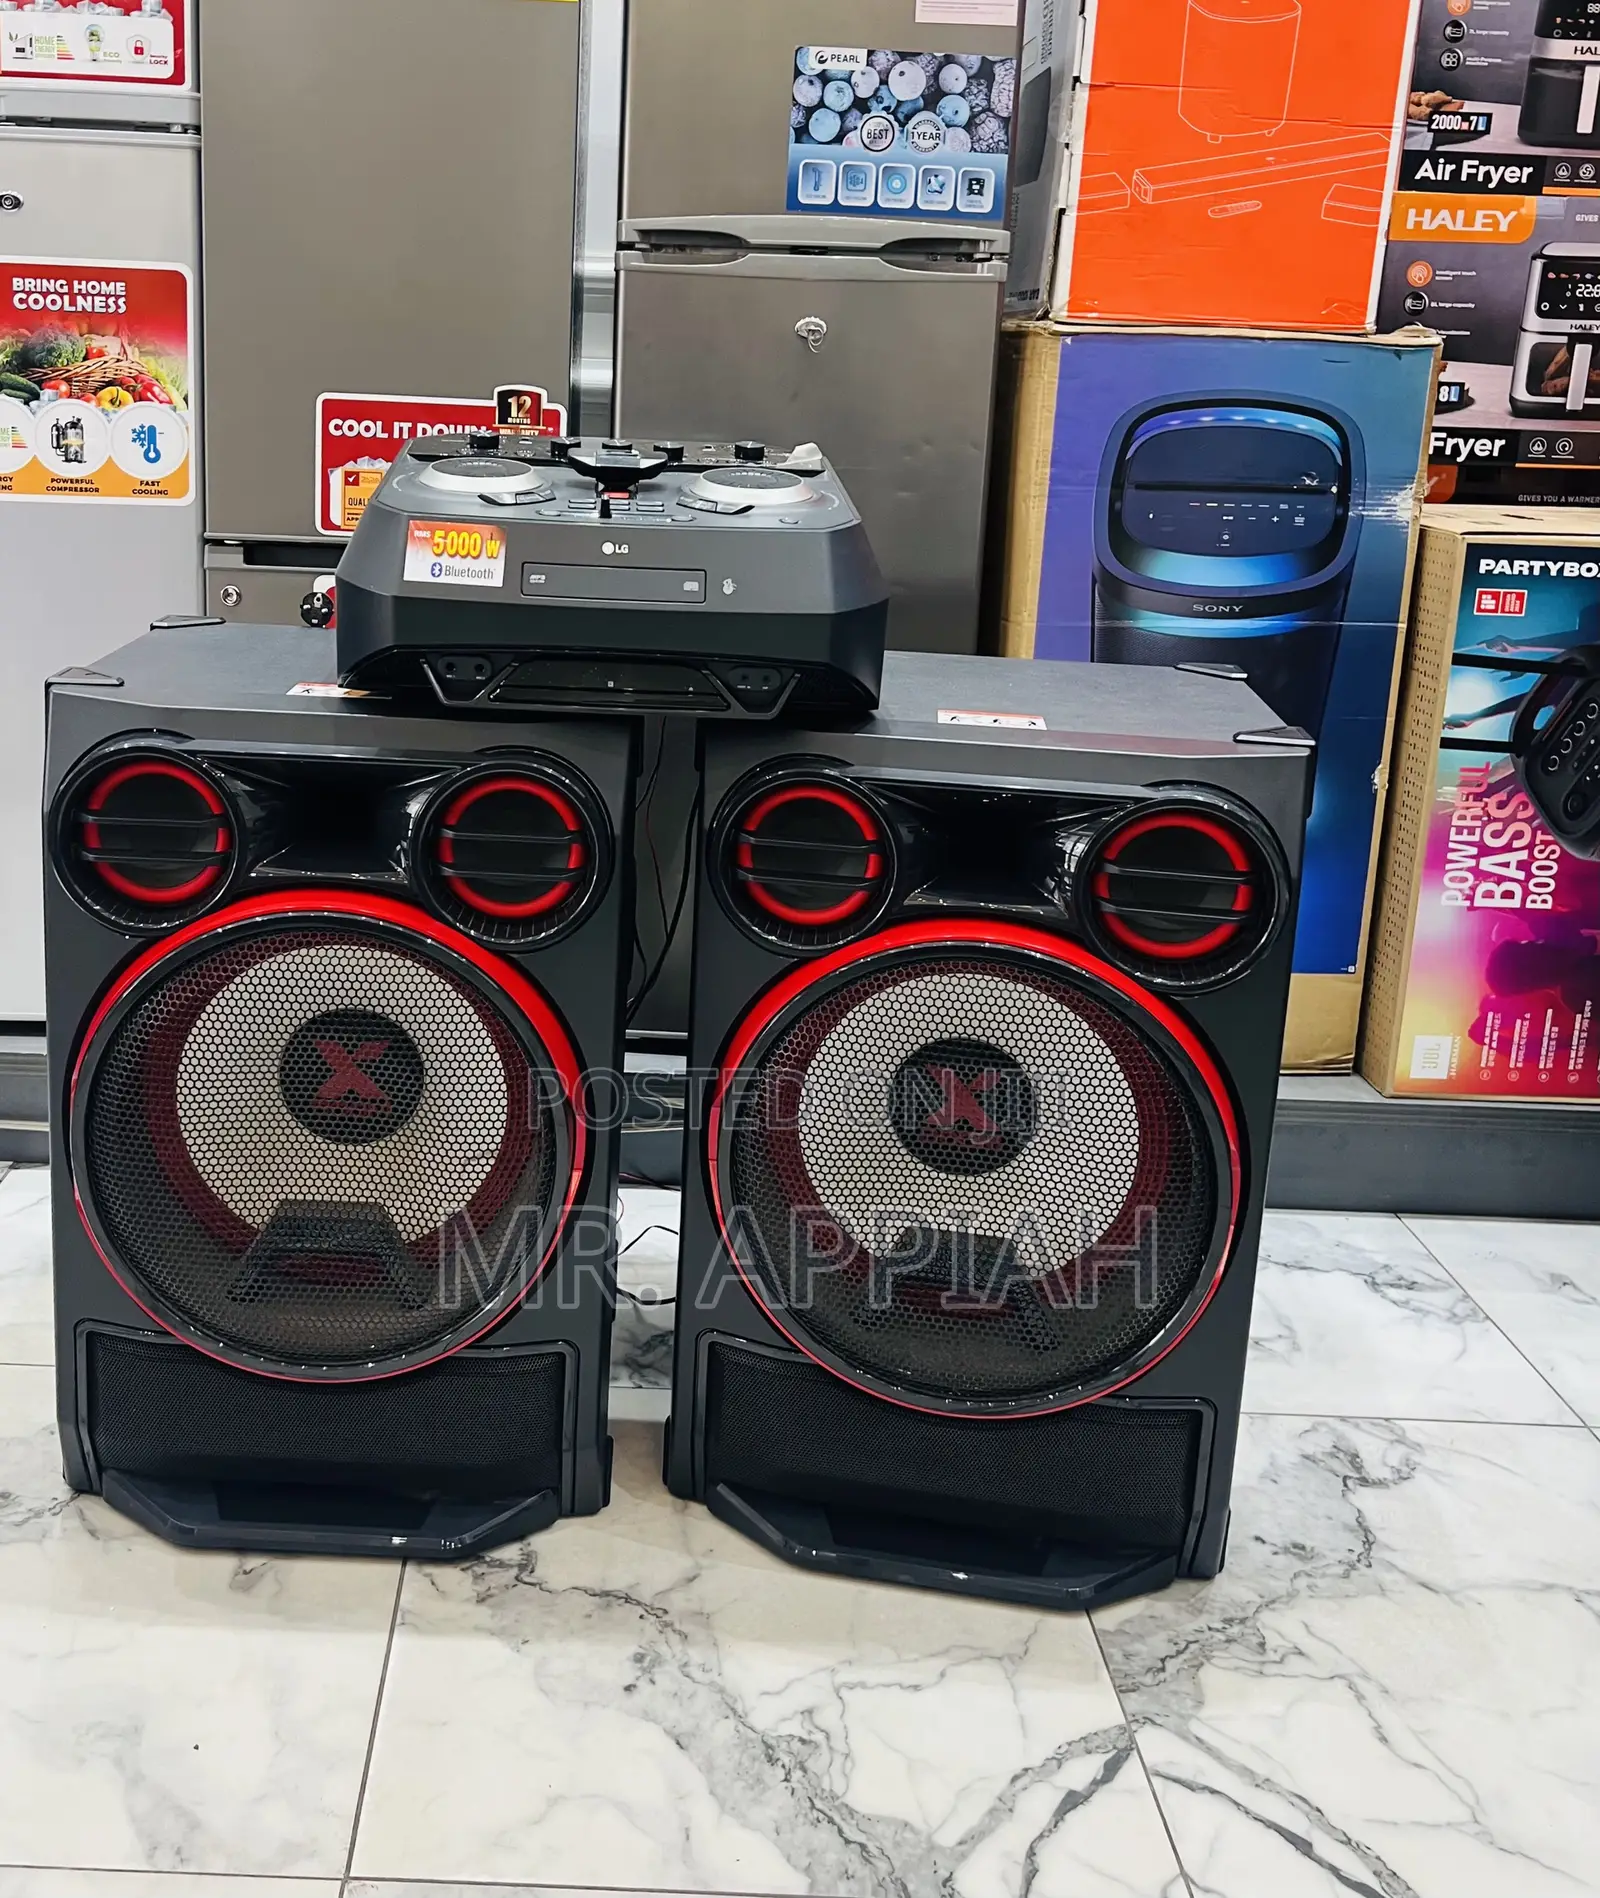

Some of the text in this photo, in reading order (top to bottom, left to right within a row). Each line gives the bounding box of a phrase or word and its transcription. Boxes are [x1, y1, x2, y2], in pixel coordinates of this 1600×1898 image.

[830, 54, 861, 63] PEARL
[867, 129, 889, 140] BEST
[917, 131, 941, 140] YEAR
[1415, 158, 1533, 189] Air Fryer
[1406, 208, 1518, 232] HALEY
[1575, 214, 1599, 222] GIVES
[12, 277, 126, 295] BRING HOME
[13, 292, 127, 314] COOLNESS
[507, 395, 532, 418] 12
[328, 418, 388, 439] COOL
[393, 421, 413, 439] IT
[1429, 432, 1506, 462] Fryer
[46, 485, 100, 493] COMPRESSOR
[50, 477, 95, 485] POWERFUL
[132, 488, 169, 496] COOLING
[1518, 494, 1541, 502] GIVES
[348, 497, 370, 506] QUAL
[414, 530, 431, 538] RMS
[432, 530, 482, 558] 5000
[615, 544, 629, 554] LG
[444, 565, 494, 580] Bluetooth
[1479, 558, 1600, 578] PARTYBO
[1192, 604, 1243, 612] SONY
[1441, 761, 1491, 907] POWERFUL
[1473, 791, 1536, 908] BASS
[1525, 830, 1561, 910] BOOST
